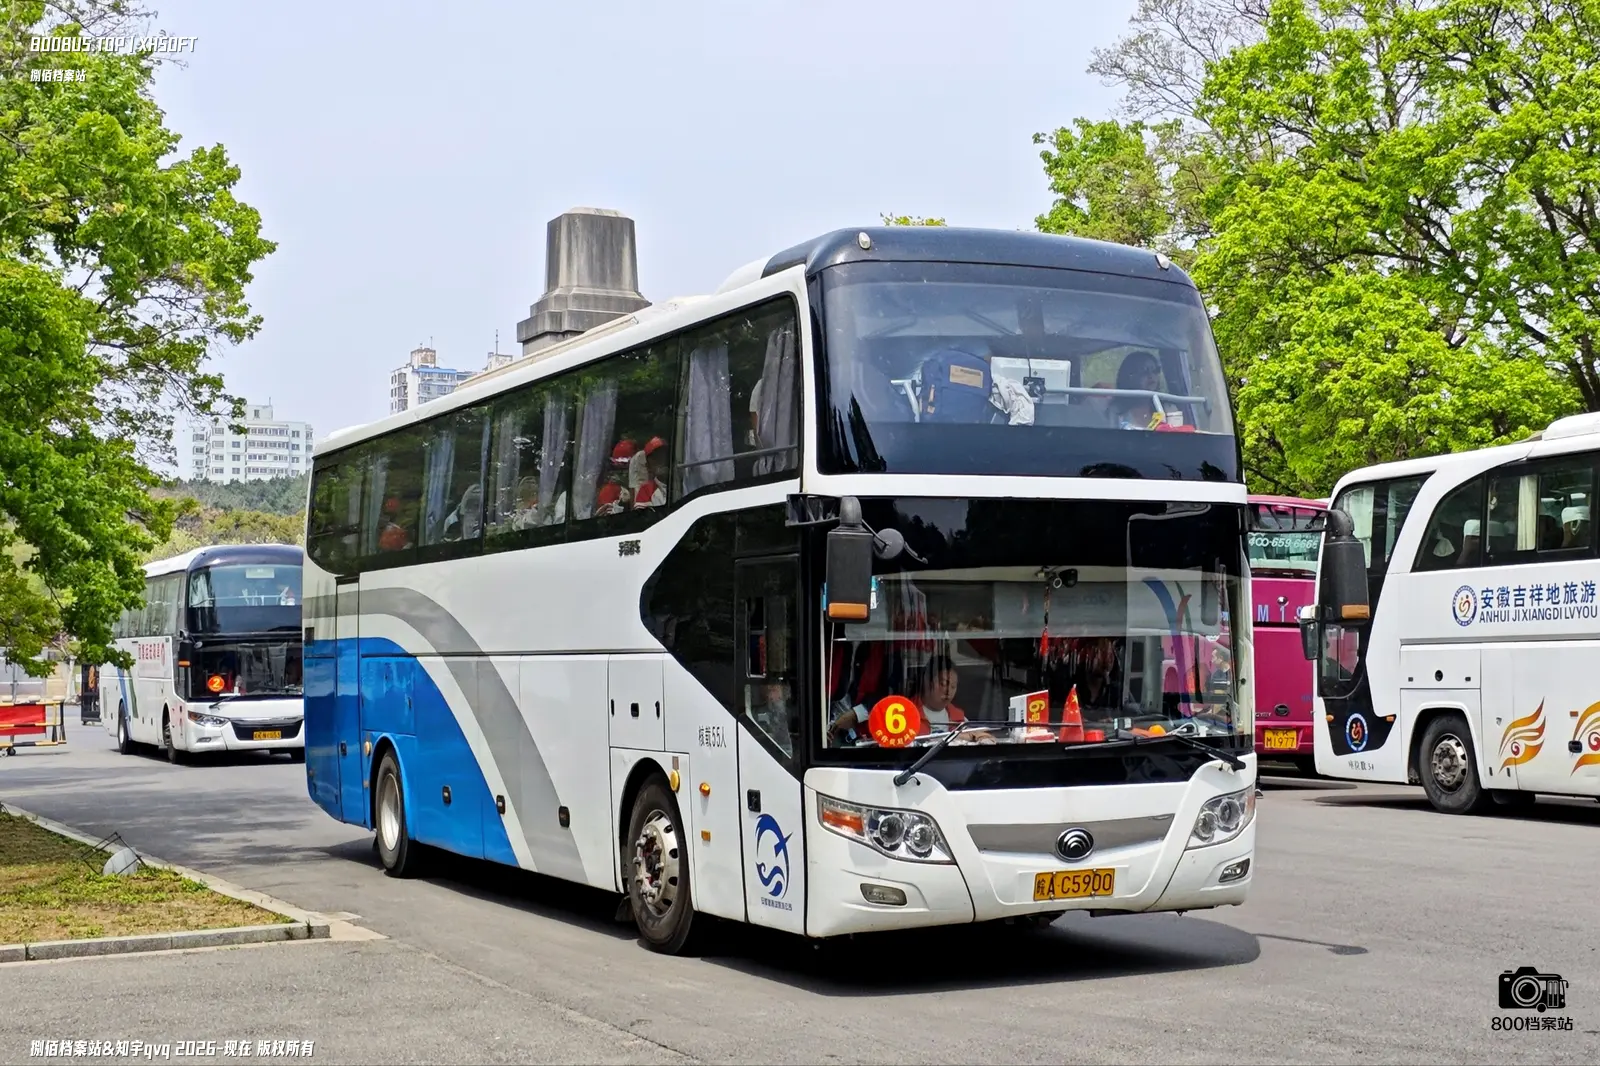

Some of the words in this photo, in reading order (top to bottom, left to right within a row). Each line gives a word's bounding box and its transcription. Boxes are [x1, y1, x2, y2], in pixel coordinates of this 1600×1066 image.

[1480, 580, 1597, 609] 安徽吉祥地旅游
[1479, 610, 1510, 623] ANHUI
[885, 702, 907, 734] 6
[698, 725, 727, 748] 核载55人
[1266, 736, 1296, 748] M1977
